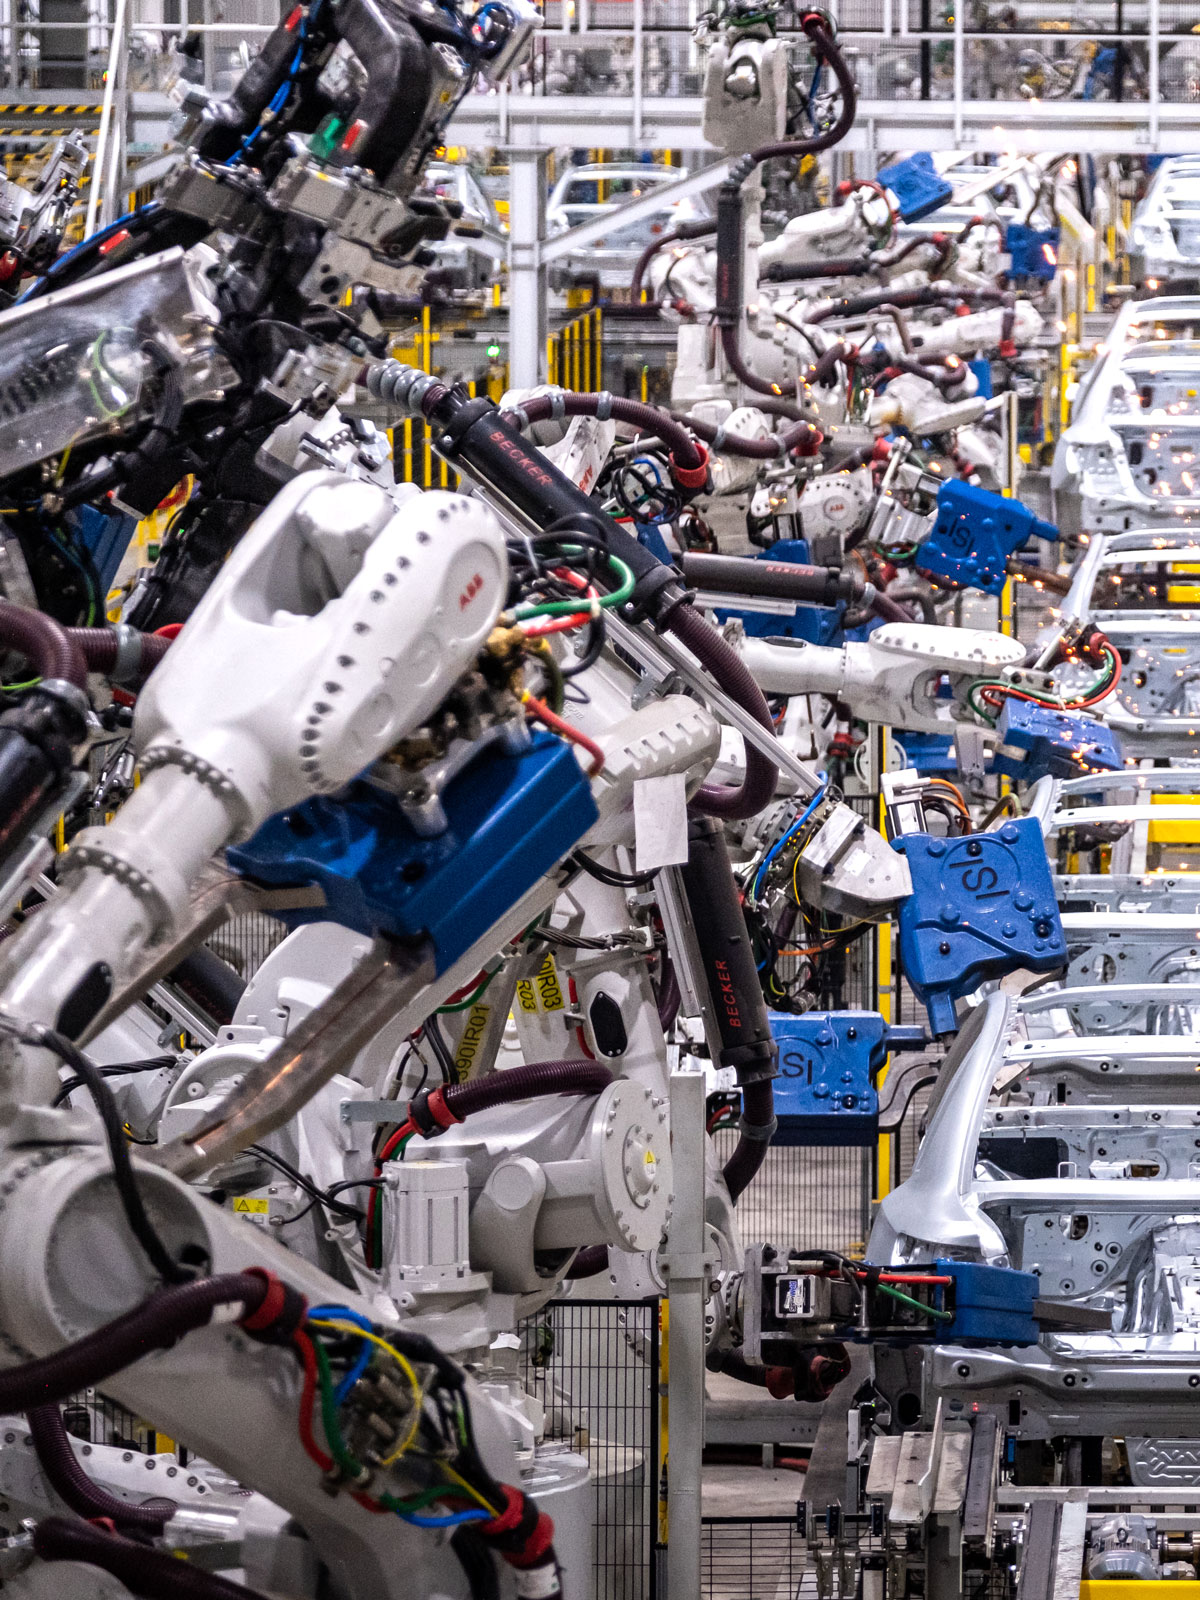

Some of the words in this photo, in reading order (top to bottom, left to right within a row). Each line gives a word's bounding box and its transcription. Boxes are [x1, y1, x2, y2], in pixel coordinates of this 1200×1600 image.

[489, 431, 553, 487] BECKER
[459, 574, 484, 609] ABB
[716, 960, 742, 1028] BECKER
